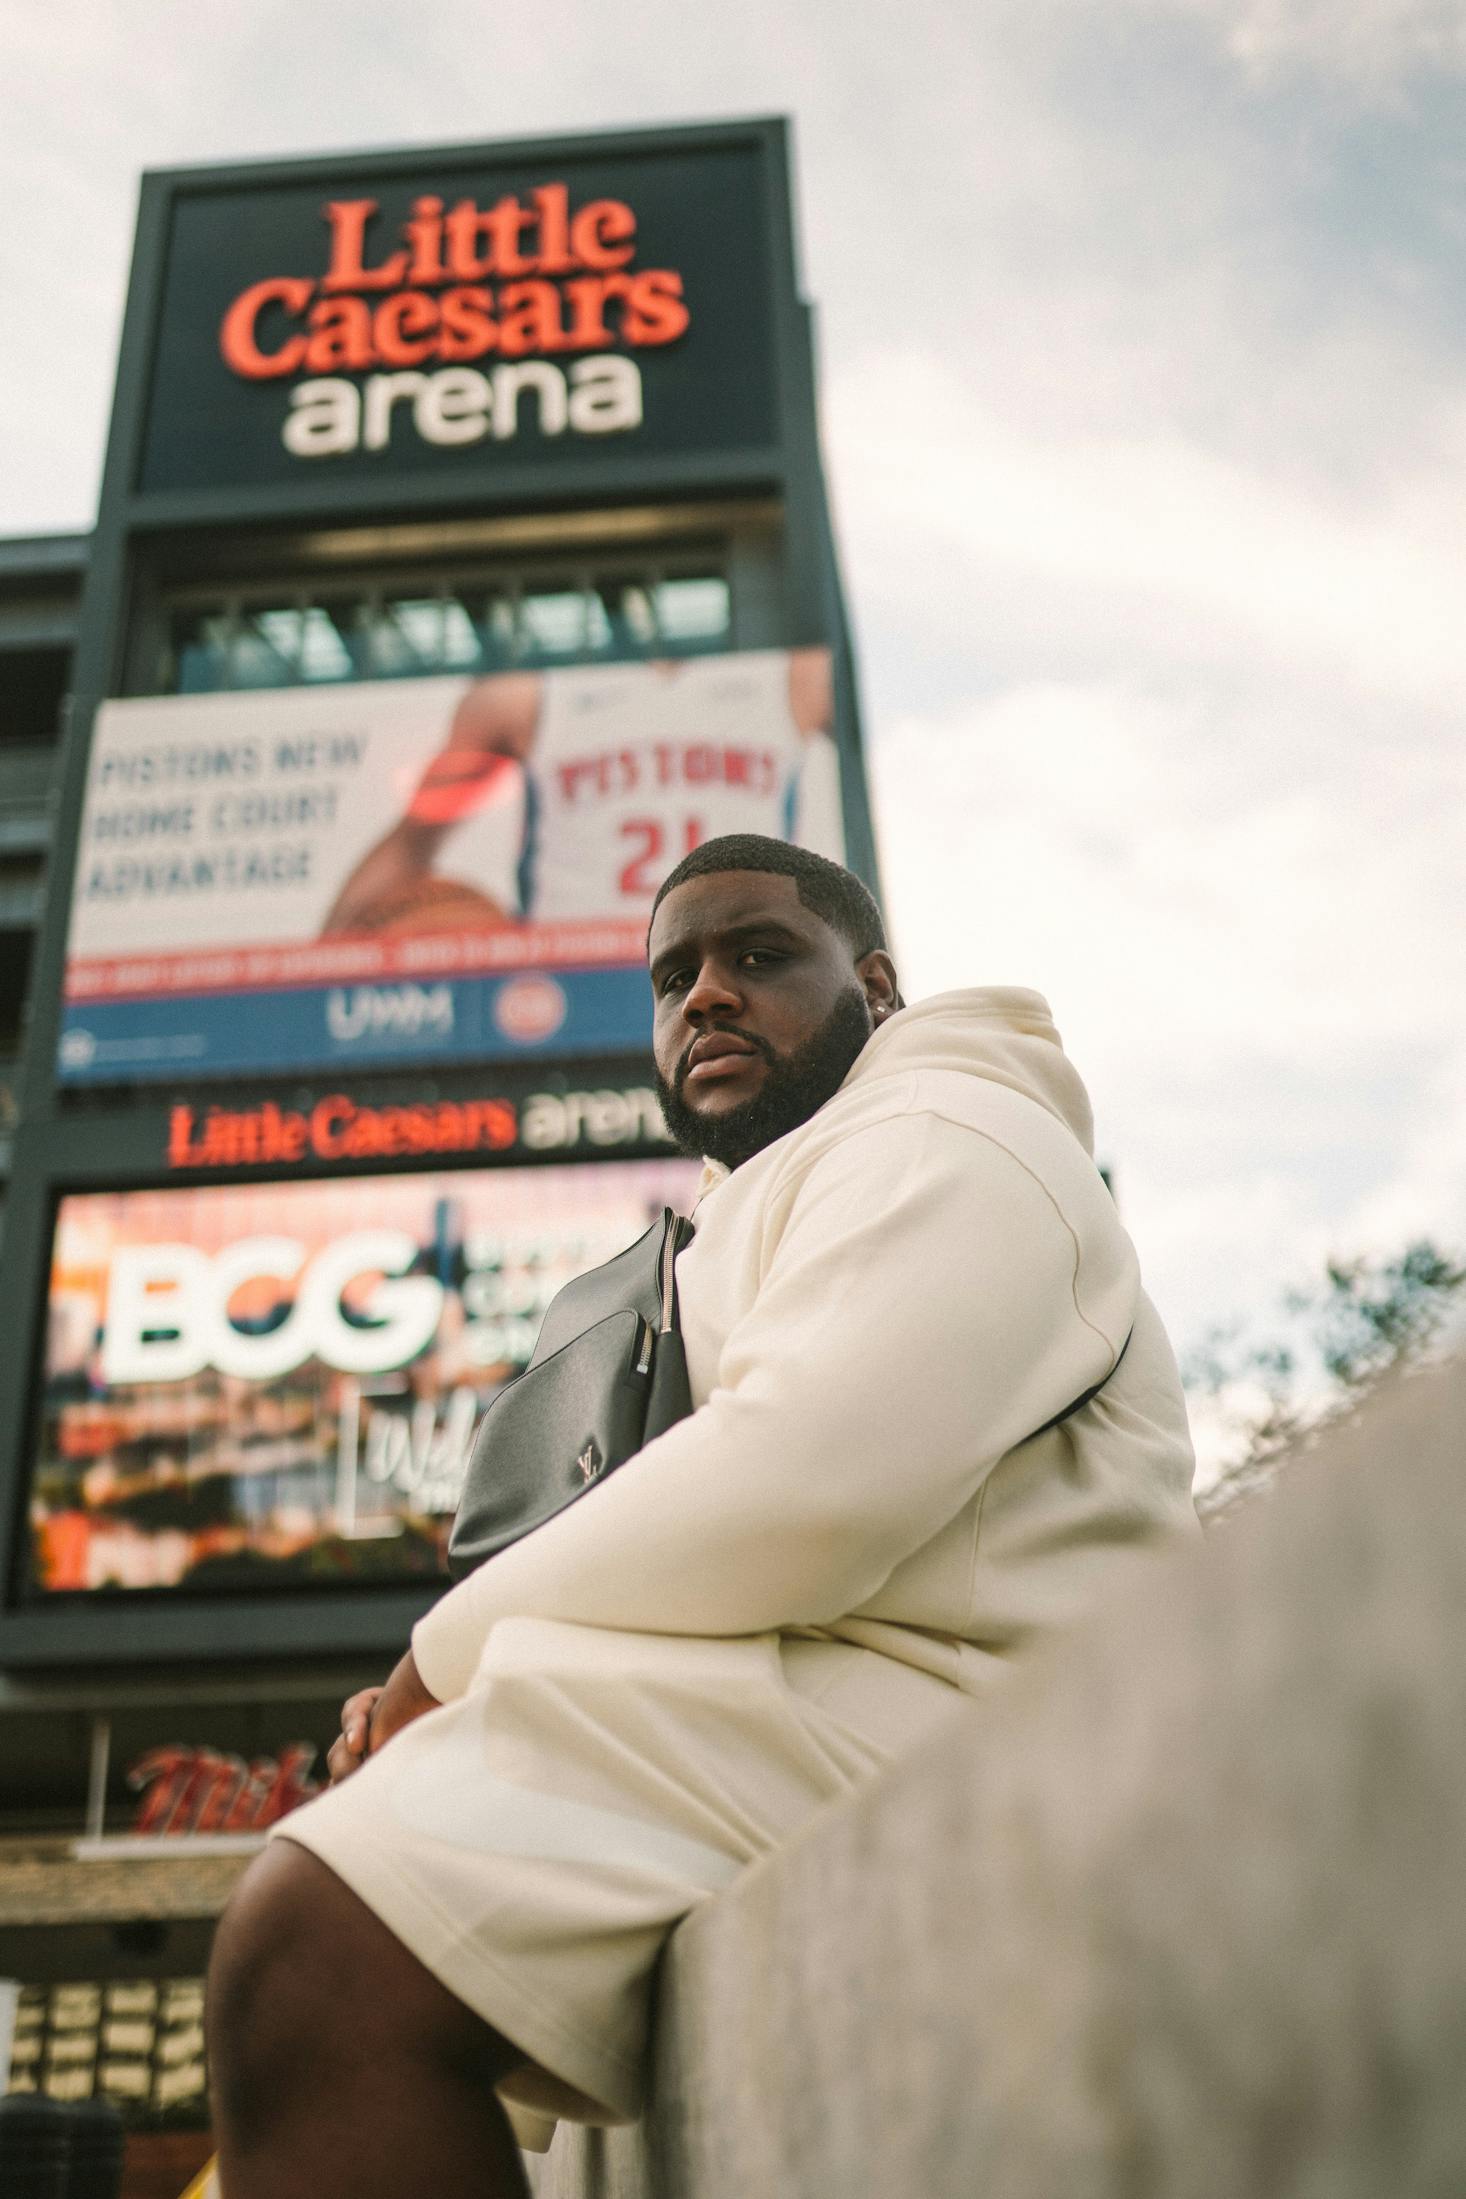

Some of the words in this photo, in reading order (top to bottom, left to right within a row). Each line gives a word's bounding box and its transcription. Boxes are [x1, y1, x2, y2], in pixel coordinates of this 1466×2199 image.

[322, 182, 637, 292] Little
[220, 269, 690, 379] Caesars
[282, 354, 642, 456] arena
[559, 744, 776, 802] PISTONS
[168, 1103, 307, 1168] Little
[311, 1094, 516, 1160] Caesars
[522, 1087, 669, 1149] aren
[103, 1229, 447, 1385] BCG
